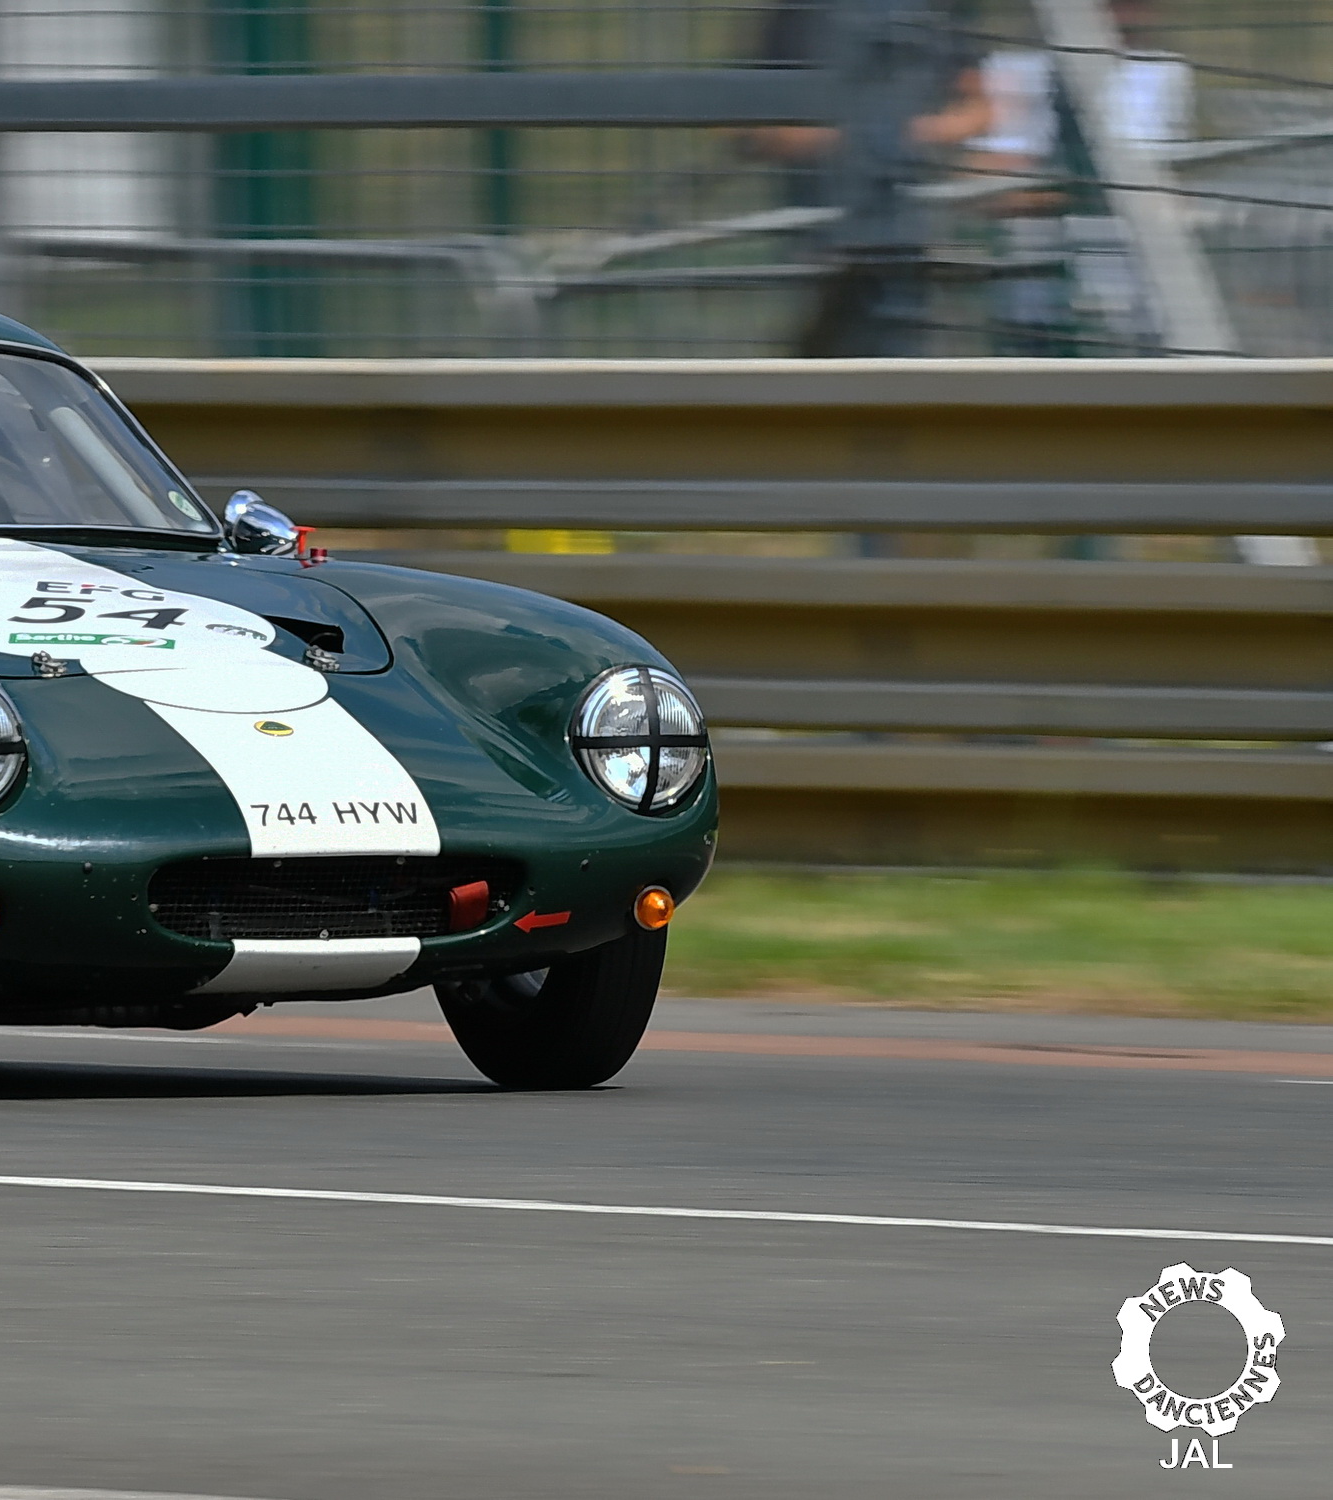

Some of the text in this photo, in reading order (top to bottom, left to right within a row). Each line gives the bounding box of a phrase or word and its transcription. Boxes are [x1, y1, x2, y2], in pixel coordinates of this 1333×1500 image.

[36, 580, 165, 601] EFG
[8, 597, 189, 630] 54
[250, 802, 417, 826] 744 HYW
